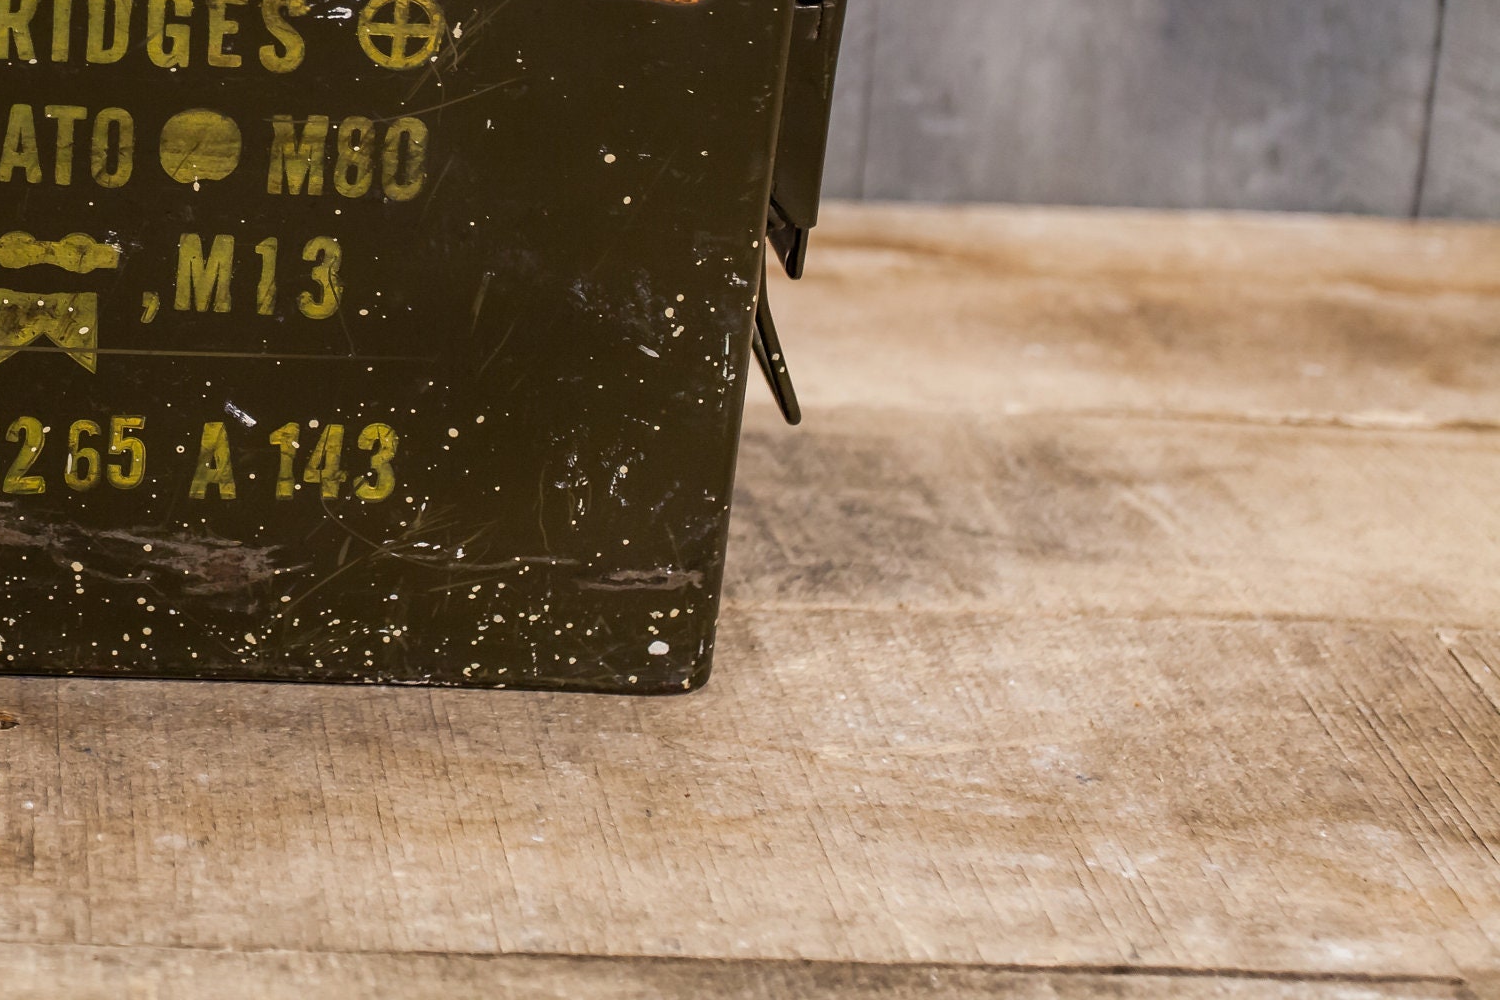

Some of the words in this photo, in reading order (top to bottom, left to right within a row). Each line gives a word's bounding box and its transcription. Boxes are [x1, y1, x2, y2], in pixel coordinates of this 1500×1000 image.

[267, 114, 429, 200] M80
[188, 422, 237, 500] A
[269, 420, 397, 504] 143
